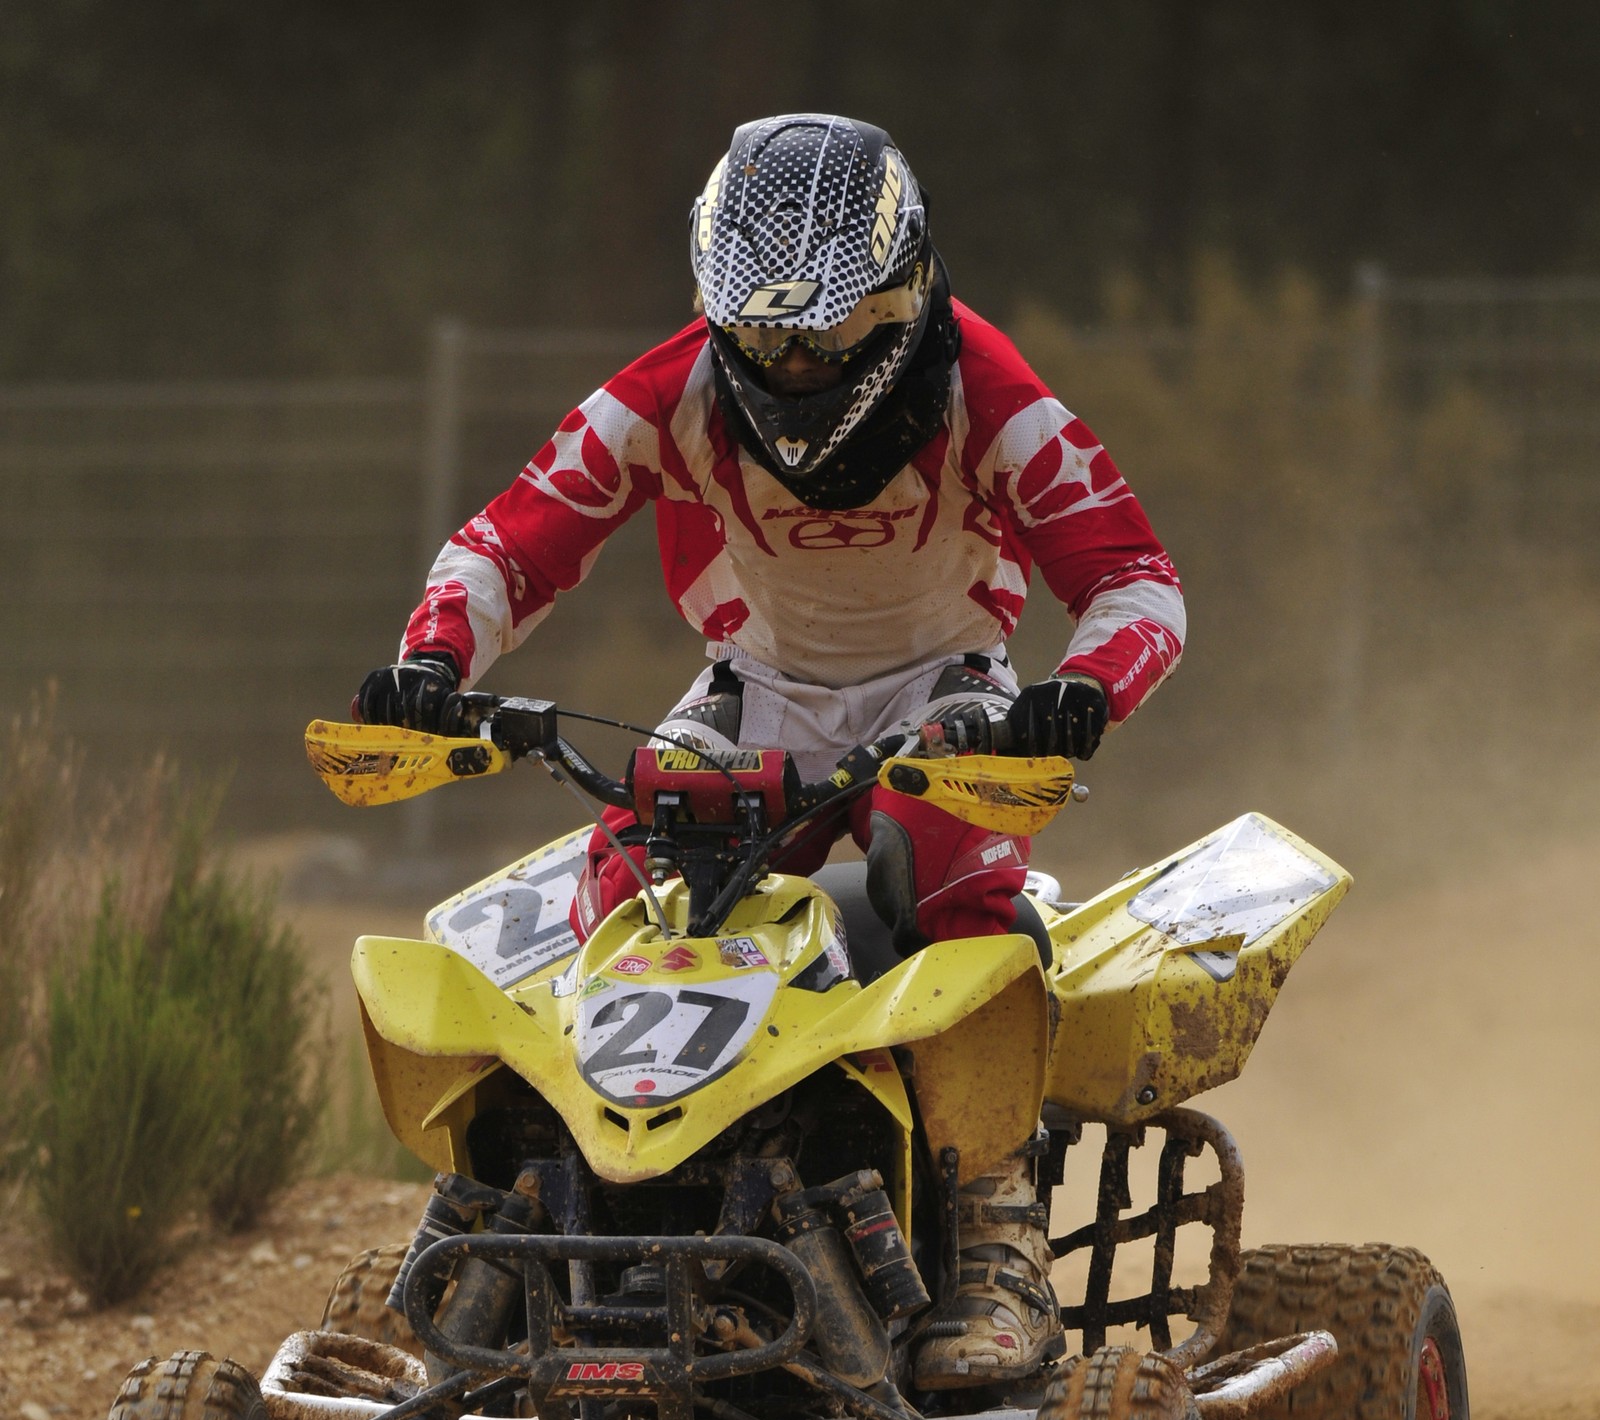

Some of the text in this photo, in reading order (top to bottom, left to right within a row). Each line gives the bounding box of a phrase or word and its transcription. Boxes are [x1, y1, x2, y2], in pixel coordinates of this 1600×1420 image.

[535, 936, 577, 957] WAD
[583, 989, 750, 1074] 27
[566, 1363, 645, 1381] IMS
